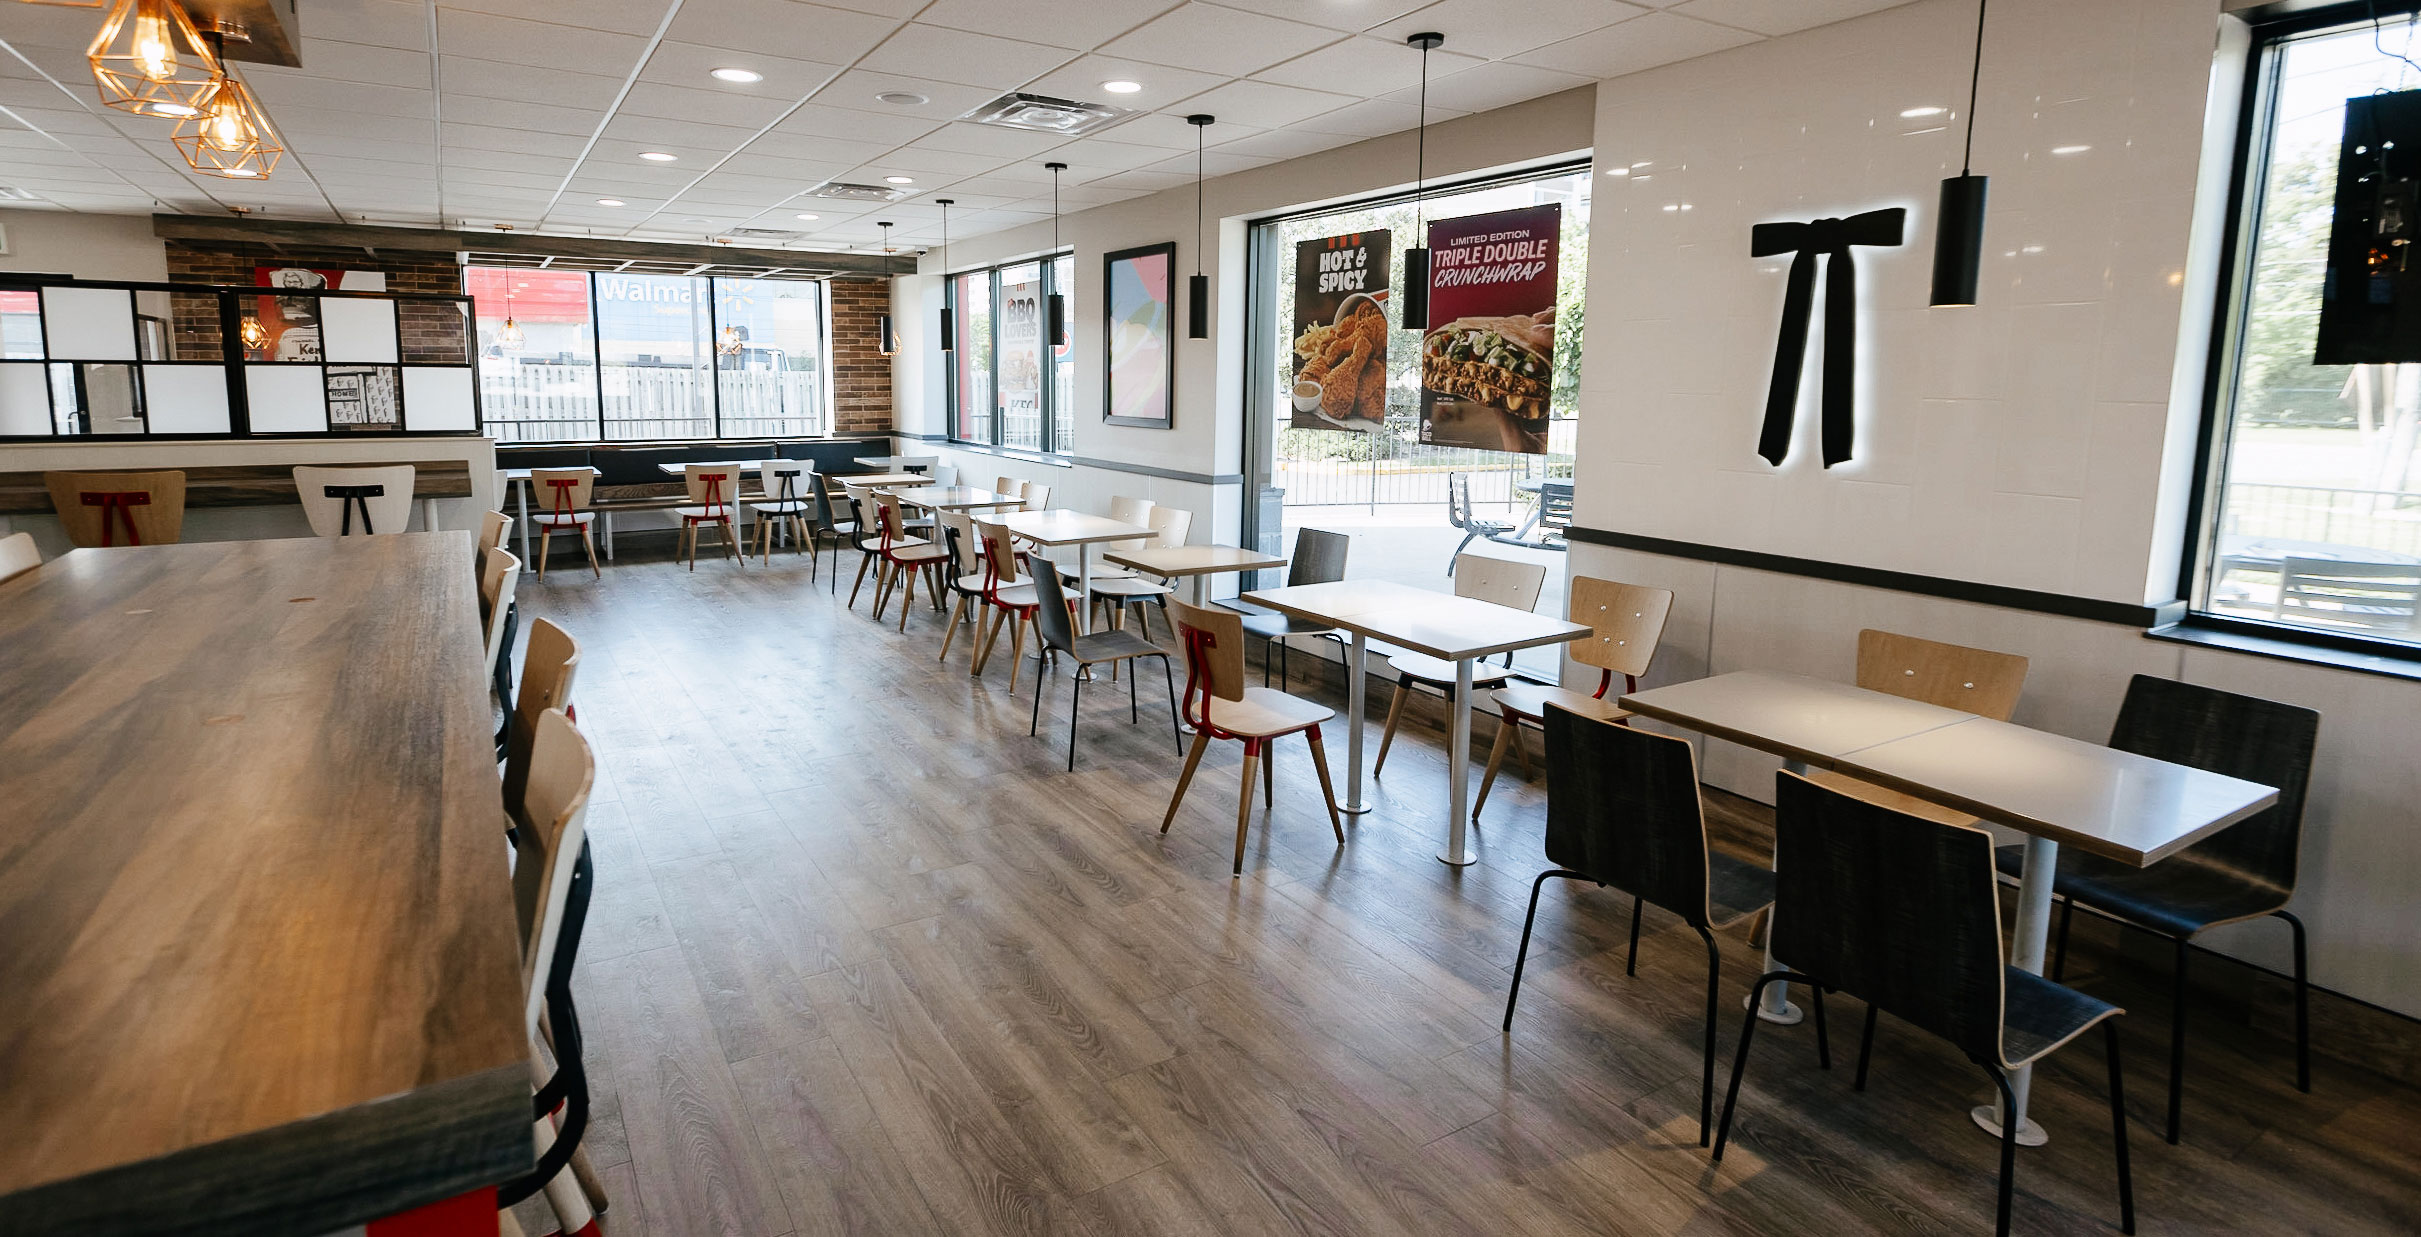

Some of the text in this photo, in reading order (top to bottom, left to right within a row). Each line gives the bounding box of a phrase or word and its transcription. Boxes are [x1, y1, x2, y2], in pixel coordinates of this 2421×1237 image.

[1450, 229, 1530, 247] LIMITED EDITION
[1319, 246, 1367, 273] HOT &
[1435, 239, 1549, 268] TRIPLE DOUBLE
[1318, 269, 1368, 293] SPICY
[1434, 261, 1547, 288] CRUNCHWRAP
[600, 279, 708, 304] Walmar
[1007, 297, 1037, 325] BBQ
[299, 343, 321, 355] Ken
